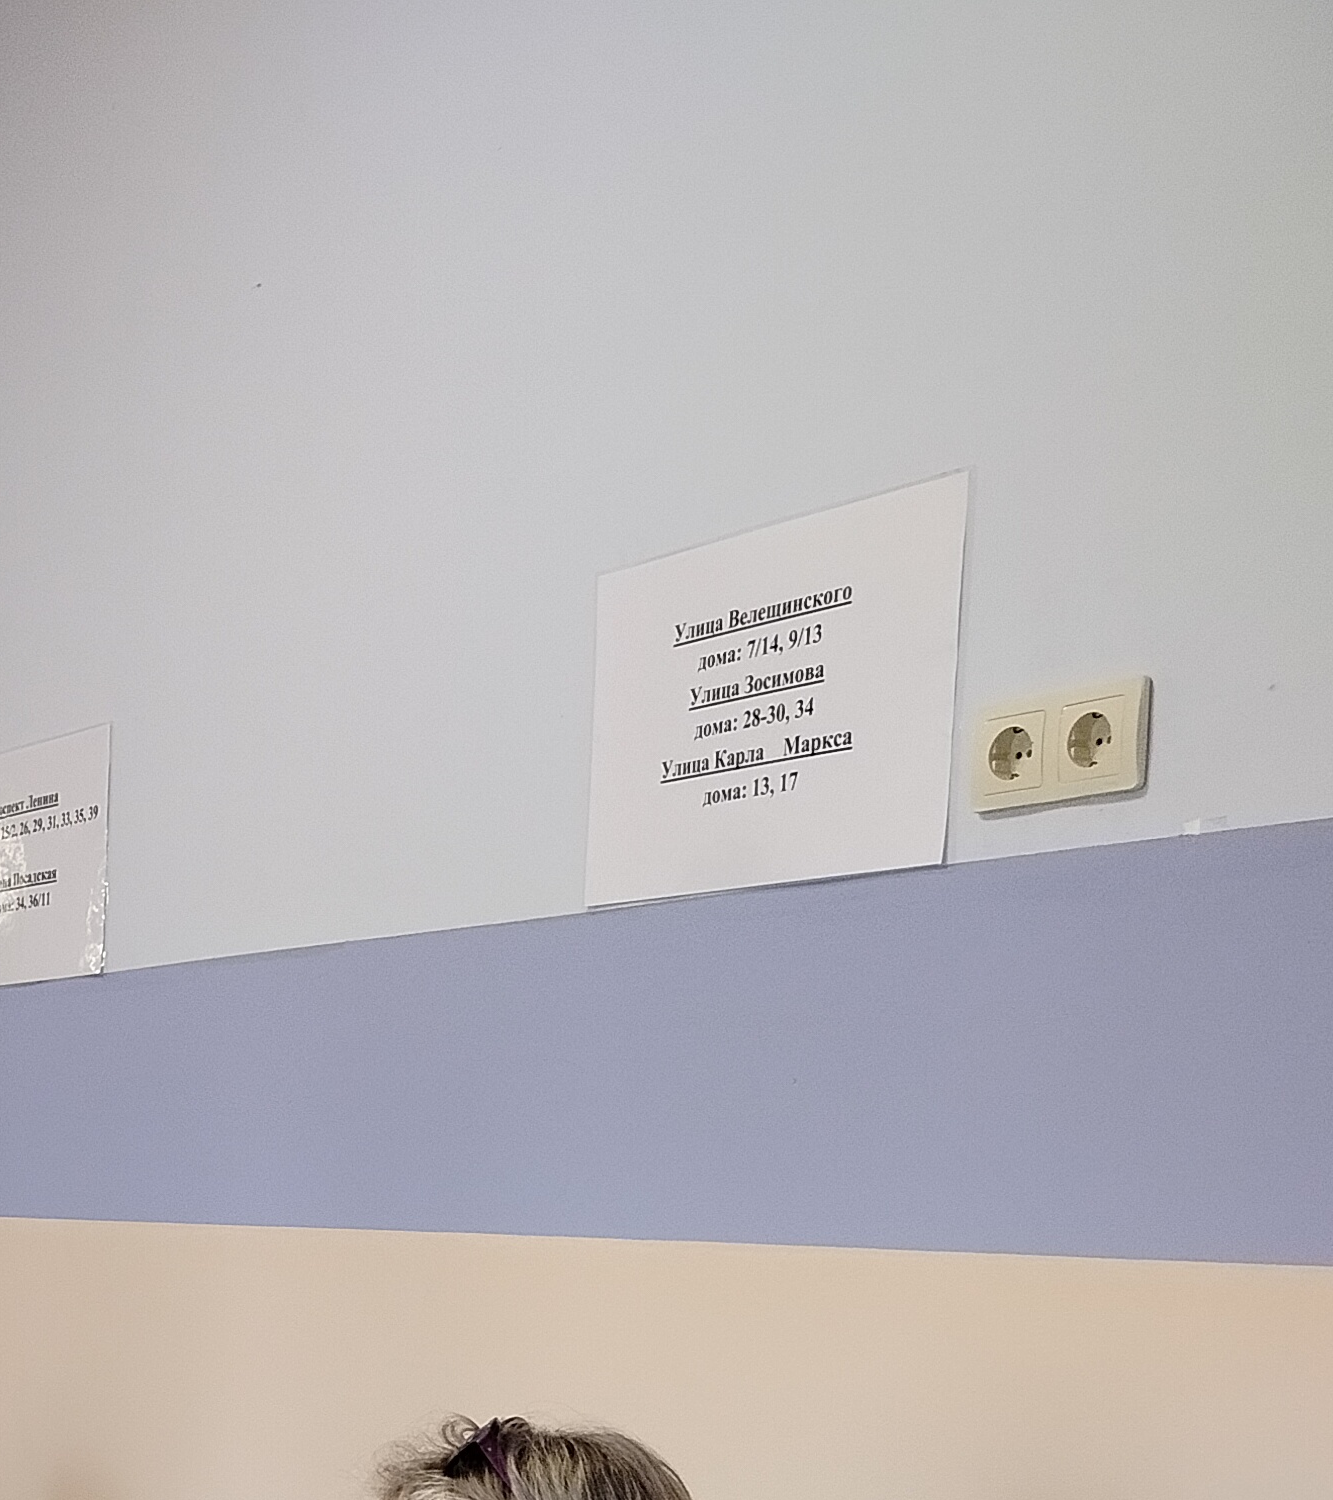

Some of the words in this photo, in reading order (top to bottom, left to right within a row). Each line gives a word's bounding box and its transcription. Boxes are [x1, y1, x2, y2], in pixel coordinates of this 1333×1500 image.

[673, 618, 723, 643] Улица
[729, 583, 853, 629] Велещинского
[698, 646, 742, 672] дома:
[747, 634, 784, 660] 7/14,
[787, 624, 823, 651] 9/13
[689, 681, 739, 708] Улица
[744, 662, 825, 696] Зосимова
[694, 716, 738, 742] дома:
[742, 703, 790, 730] 28-30,
[794, 697, 814, 720] 34
[661, 758, 709, 782] Улица
[714, 744, 764, 774] Карла
[783, 727, 853, 762] Маркса
[26, 792, 59, 809] Ленина
[702, 784, 747, 808] дома:
[752, 777, 776, 800] 13,
[780, 771, 798, 793] 17
[33, 817, 45, 833] 29,
[47, 814, 59, 830] 31,
[61, 811, 73, 827] 33,
[75, 808, 87, 823] 35,
[88, 805, 99, 820] 39
[28, 892, 50, 908] 36/11
